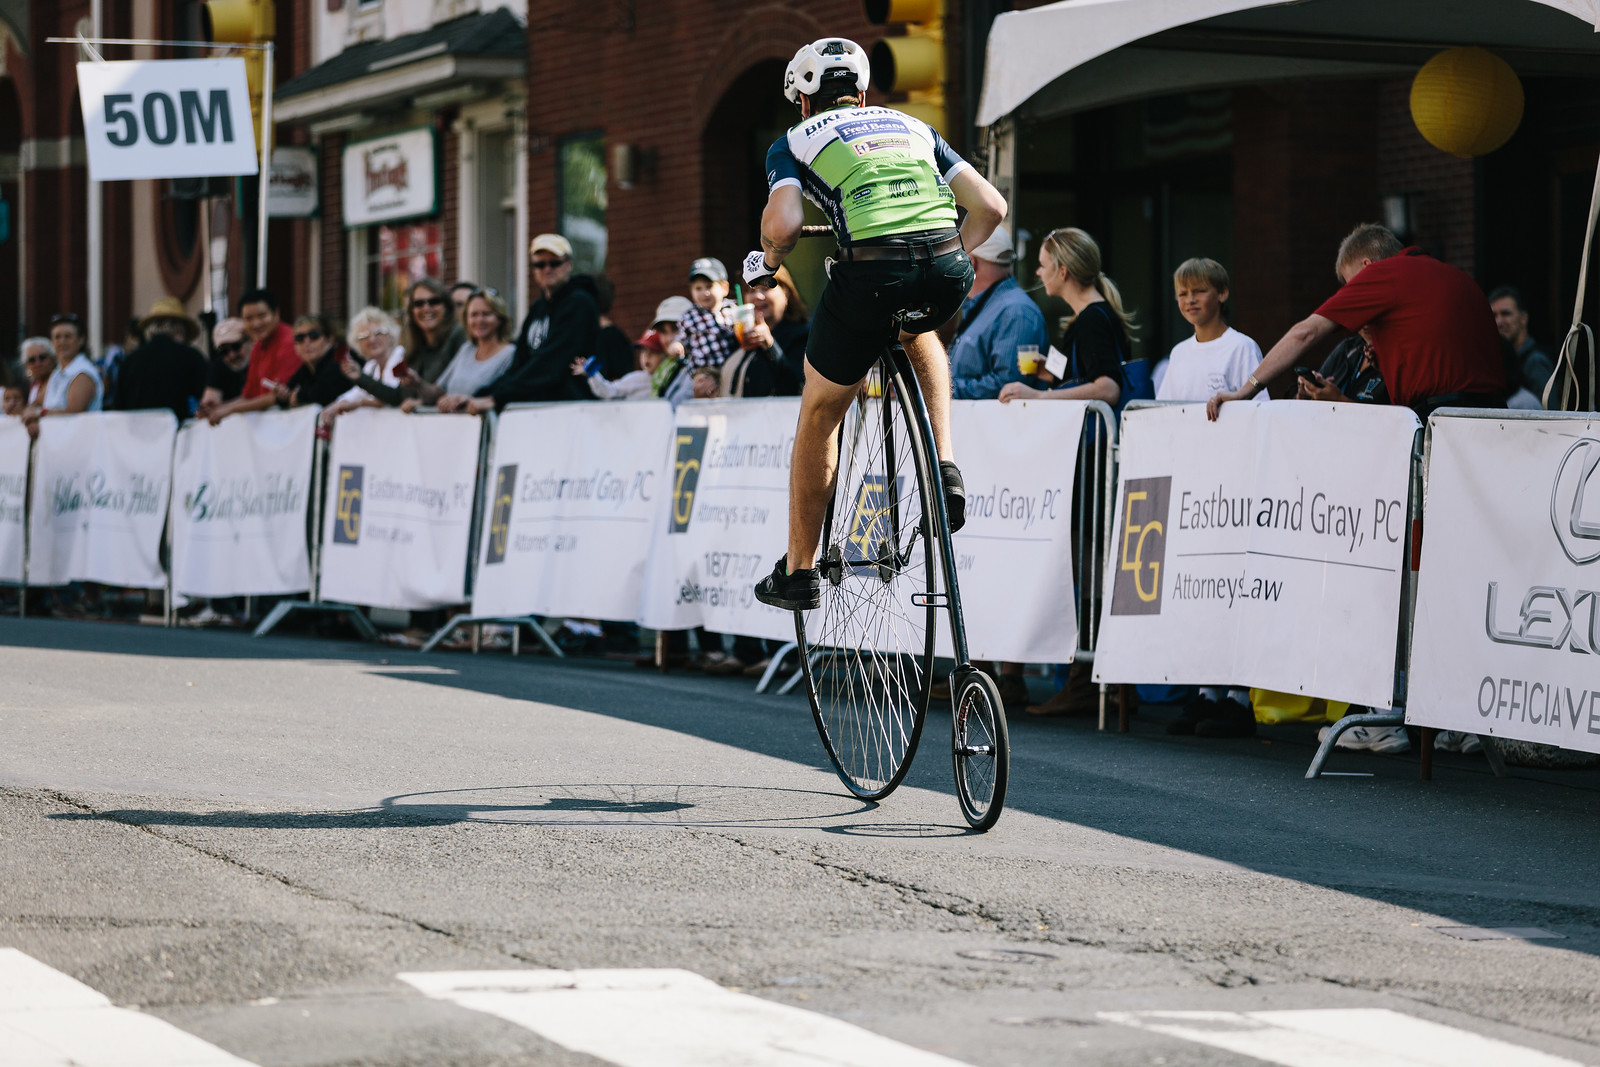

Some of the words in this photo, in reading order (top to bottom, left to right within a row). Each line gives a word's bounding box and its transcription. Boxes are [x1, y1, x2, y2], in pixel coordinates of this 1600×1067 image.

[103, 89, 235, 147] 50M
[842, 123, 870, 136] Fred
[869, 122, 906, 131] Beans
[890, 189, 920, 199] ARCCA
[1000, 487, 1036, 531] Gray,
[1040, 489, 1062, 521] PC
[1256, 486, 1304, 532] and
[1310, 492, 1365, 553] Gray,
[1373, 498, 1401, 543] PC
